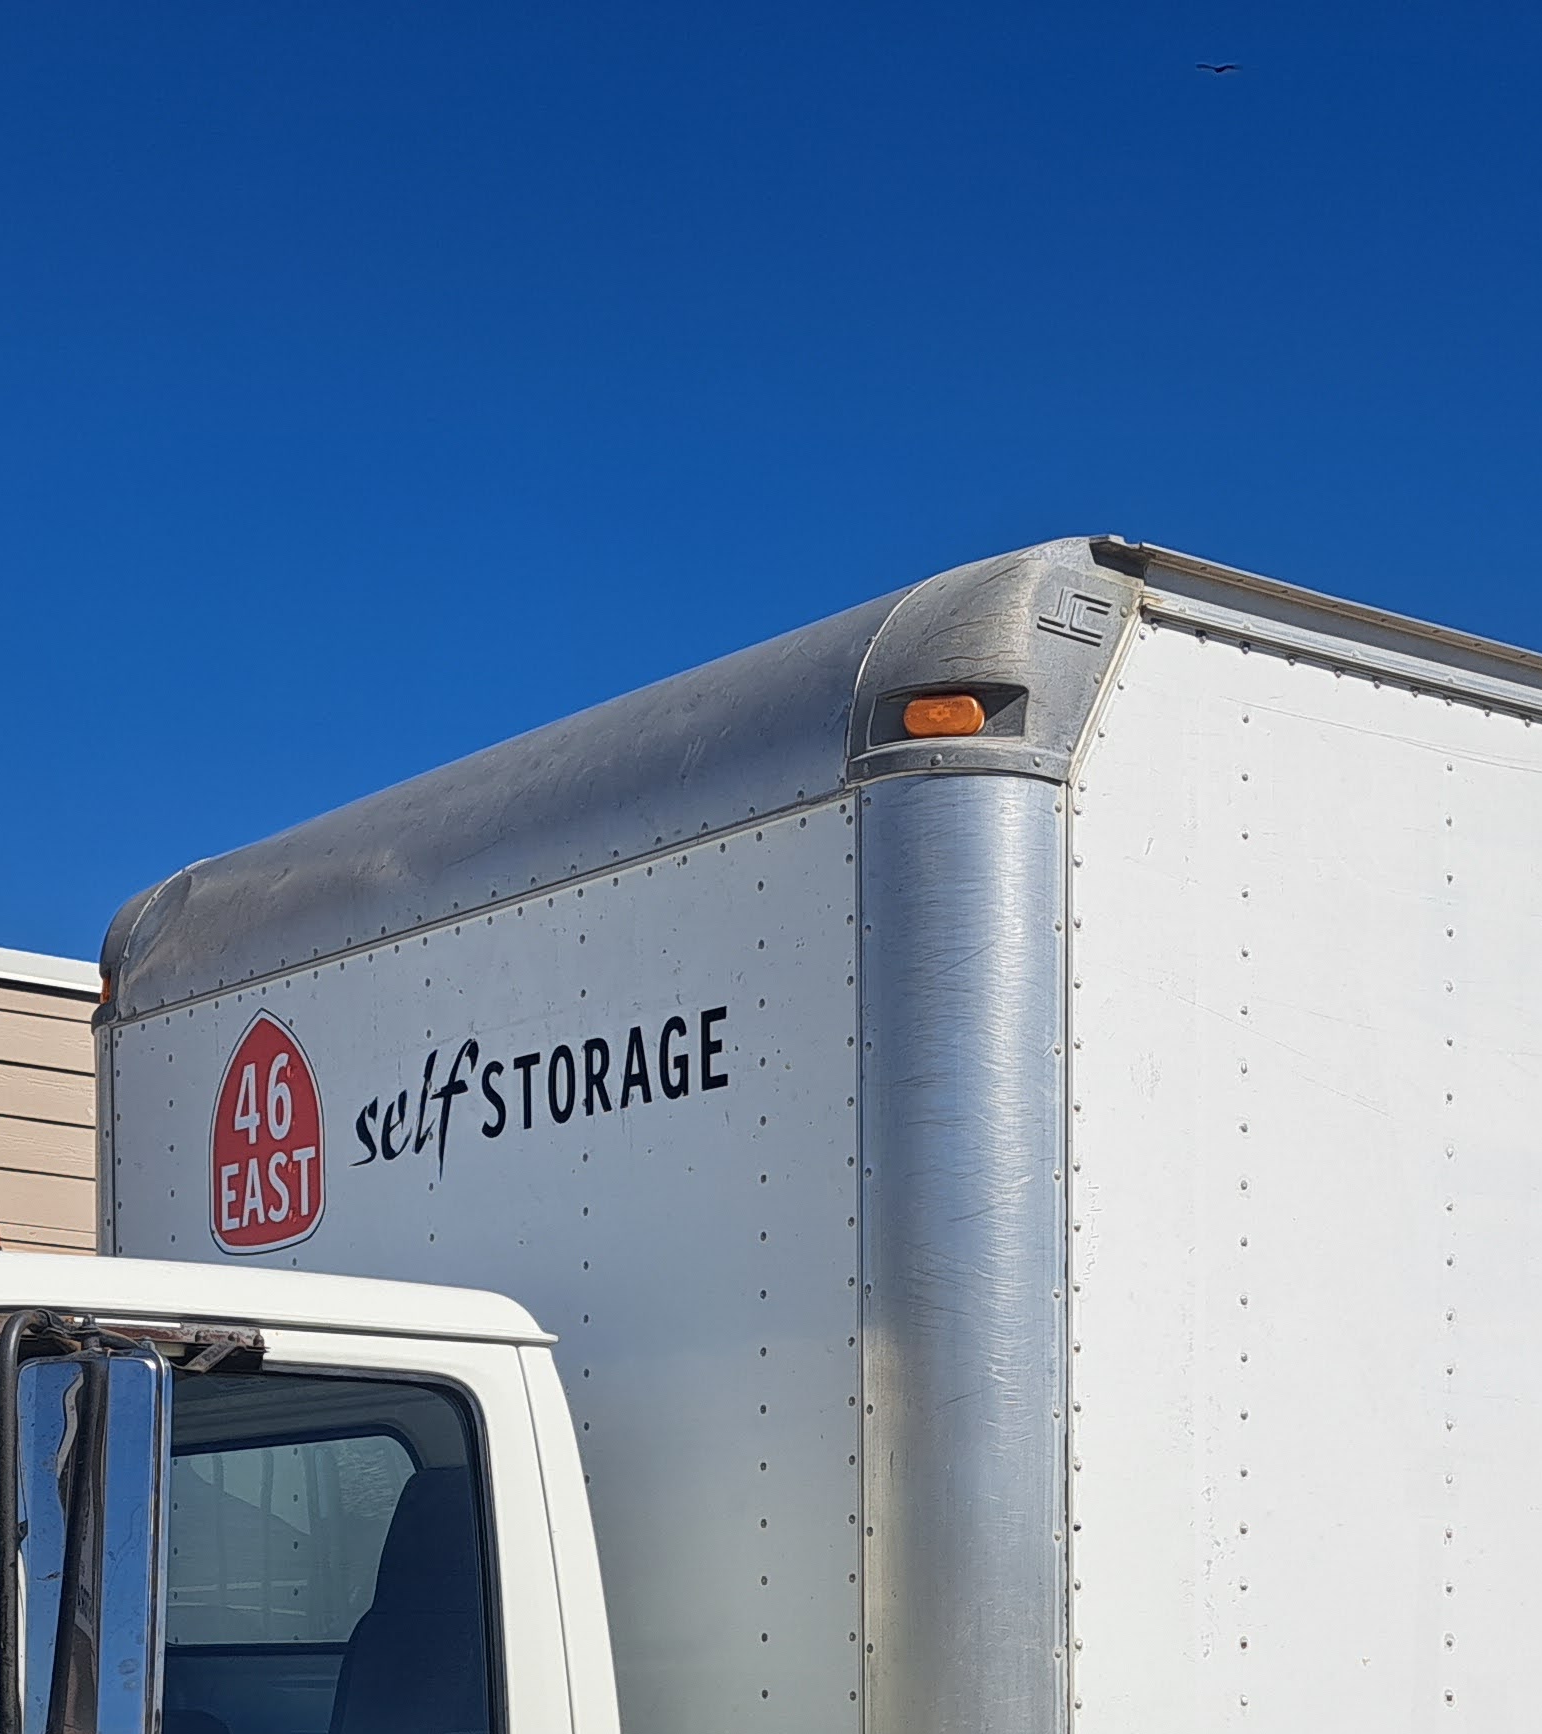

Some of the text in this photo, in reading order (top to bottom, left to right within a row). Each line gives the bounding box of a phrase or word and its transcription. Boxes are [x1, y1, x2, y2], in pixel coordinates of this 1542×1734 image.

[234, 1052, 292, 1144] 46
[350, 1005, 729, 1182] self STORAGE
[220, 1146, 317, 1232] EAST
